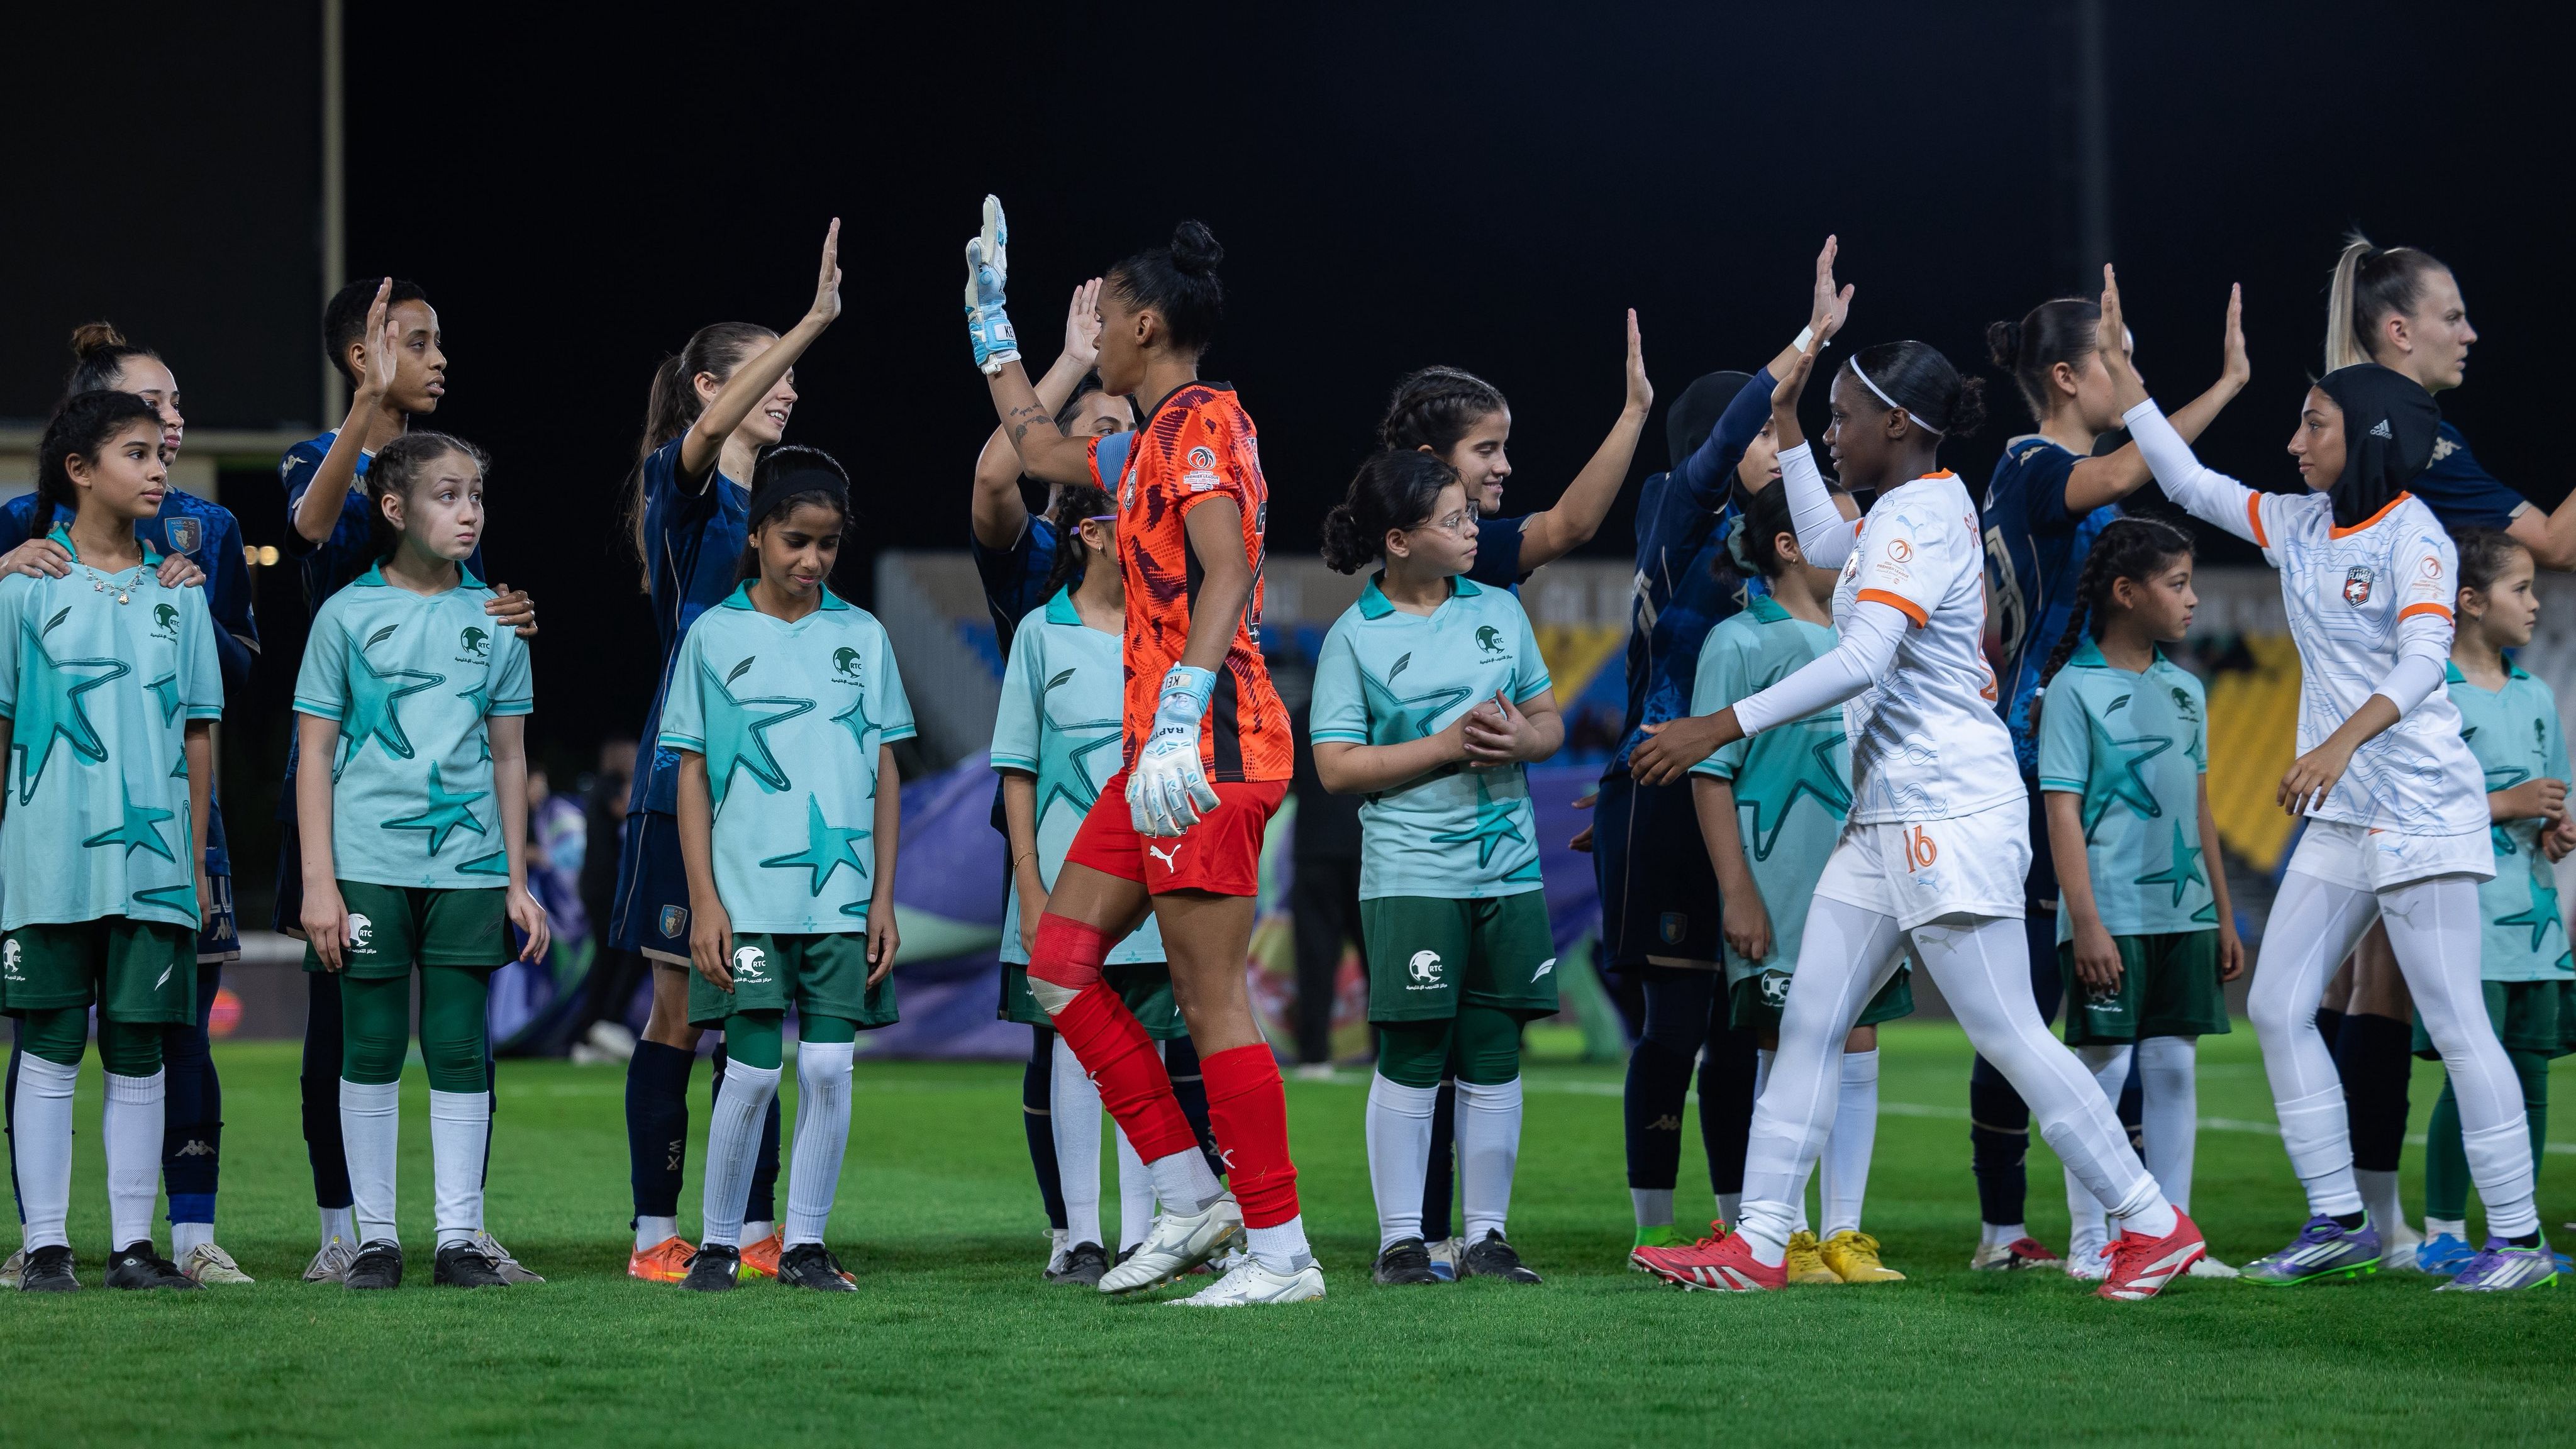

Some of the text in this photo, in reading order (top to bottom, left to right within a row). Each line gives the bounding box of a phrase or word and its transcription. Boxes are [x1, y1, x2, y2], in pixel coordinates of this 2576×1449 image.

[2370, 429, 2392, 440] adidas
[2348, 572, 2371, 583] FLAMES
[170, 619, 180, 628] RTC
[1903, 824, 1938, 874] 16
[1385, 1245, 1410, 1256] PATRICK
